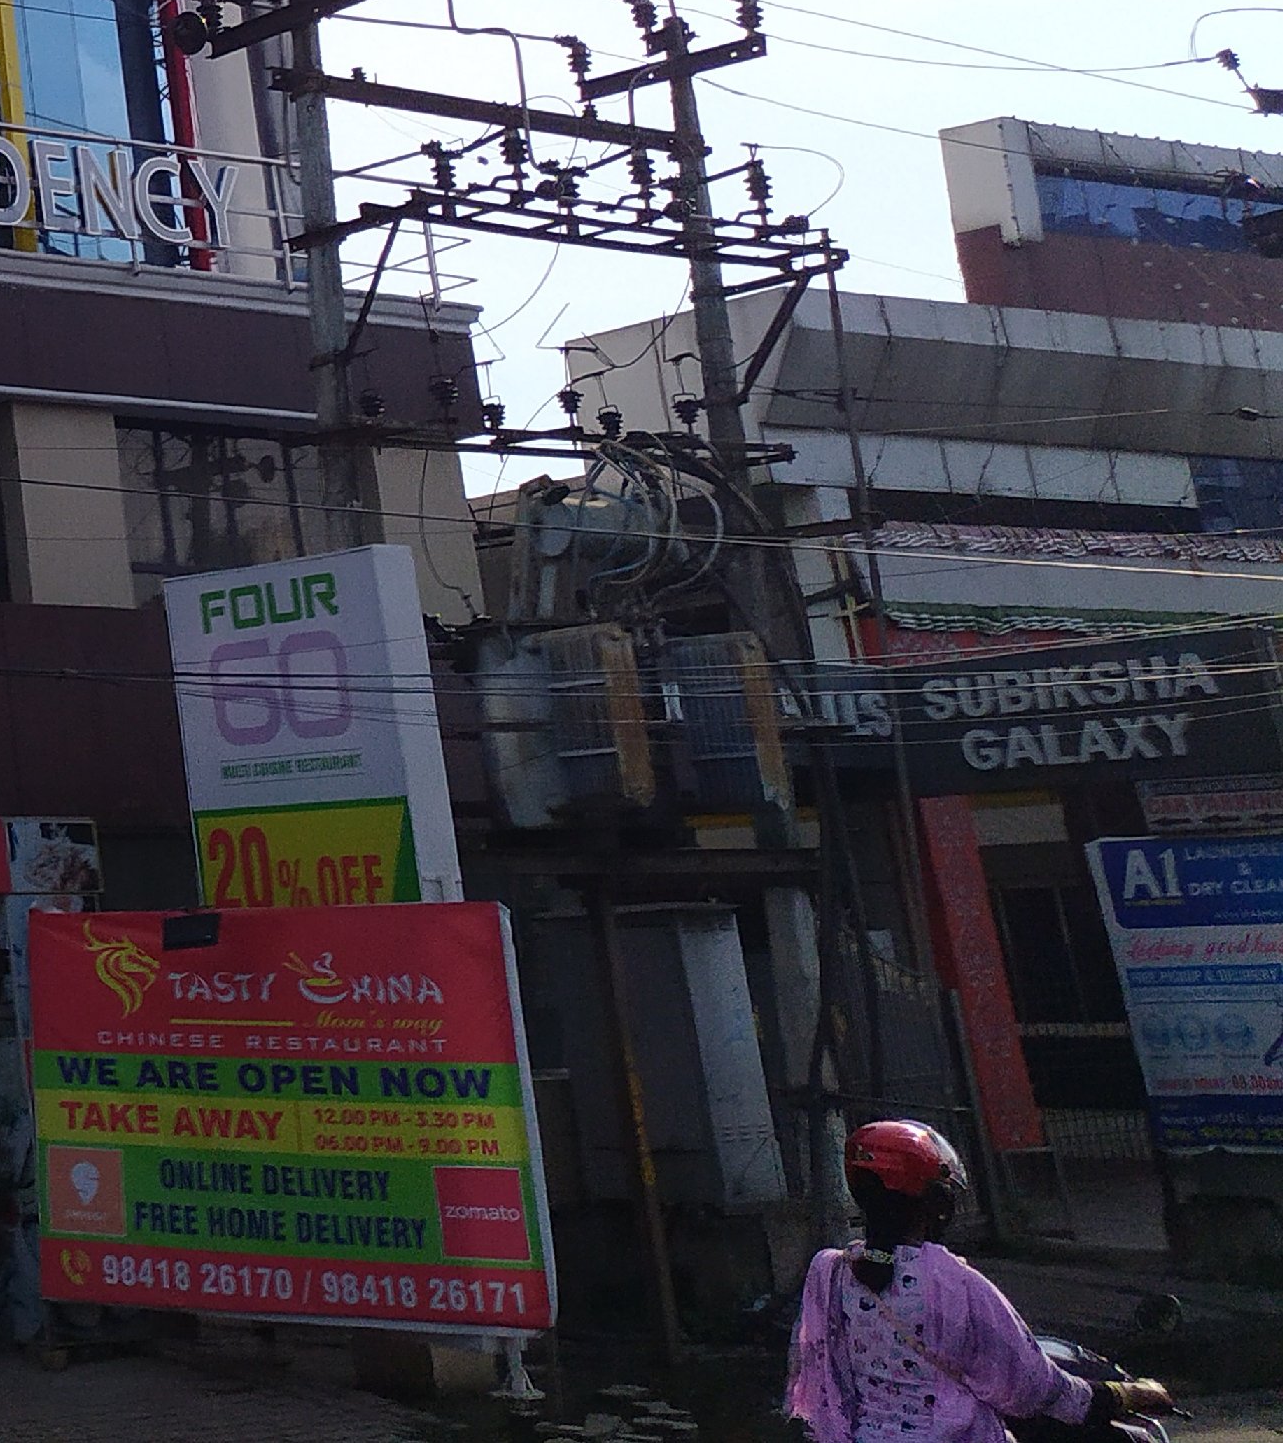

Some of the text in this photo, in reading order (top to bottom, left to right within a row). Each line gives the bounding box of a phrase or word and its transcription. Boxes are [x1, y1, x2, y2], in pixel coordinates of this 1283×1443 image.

[200, 572, 339, 635] FOUR
[211, 630, 352, 746] 60
[921, 652, 1220, 721] SUBIKSHA
[962, 713, 1188, 772] GALAXY
[317, 854, 383, 906] OFF
[1123, 847, 1184, 899] A1
[167, 971, 277, 1004] TASTY
[96, 1030, 448, 1054] CHINESE RESTAURANT
[57, 1056, 491, 1099] WE ARE OPEN NOW
[59, 1100, 283, 1141] TAKE AWAY
[369, 1109, 401, 1127] PM
[462, 1112, 496, 1130] PM
[372, 1135, 403, 1153] PM
[466, 1139, 500, 1156] PM
[160, 1159, 391, 1201] ONLINE DELIVERY
[135, 1202, 427, 1250] FREE HOME DELIVERY
[444, 1205, 521, 1222] zomato
[102, 1255, 191, 1292] 98418
[199, 1262, 294, 1300] 26170
[321, 1270, 418, 1308] 98418
[429, 1277, 527, 1315] 26171
